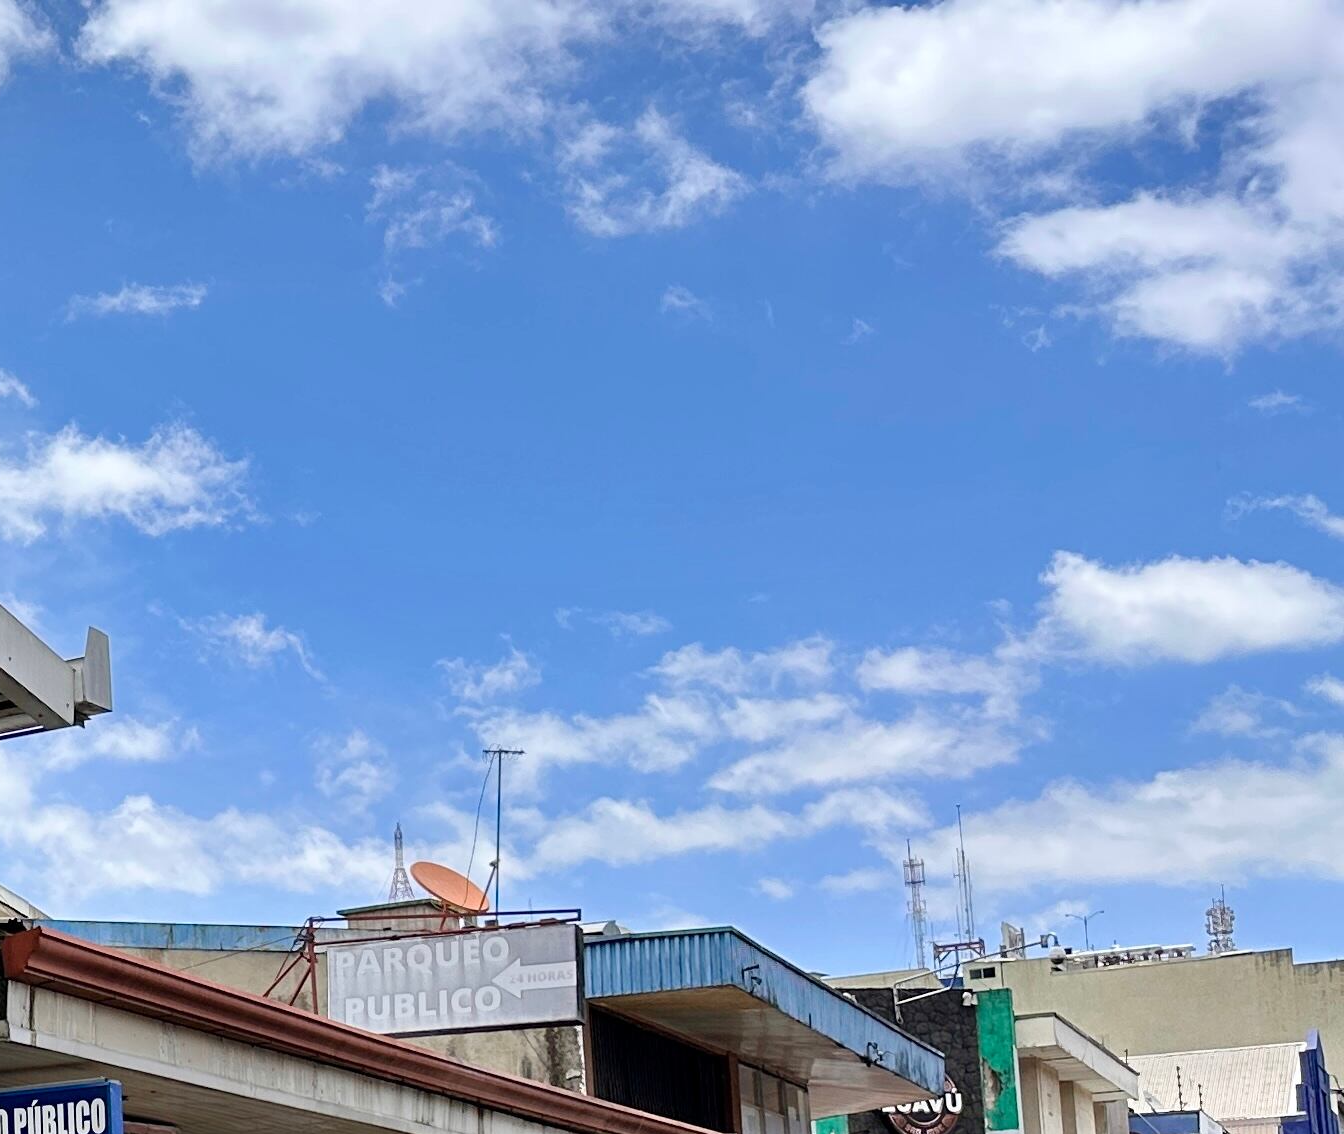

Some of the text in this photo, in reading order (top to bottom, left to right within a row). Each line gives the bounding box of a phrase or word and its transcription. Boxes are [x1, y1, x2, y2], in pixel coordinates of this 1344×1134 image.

[336, 936, 510, 977] PARQUEO
[526, 968, 575, 983] HORAS
[345, 985, 502, 1025] PUBLICO
